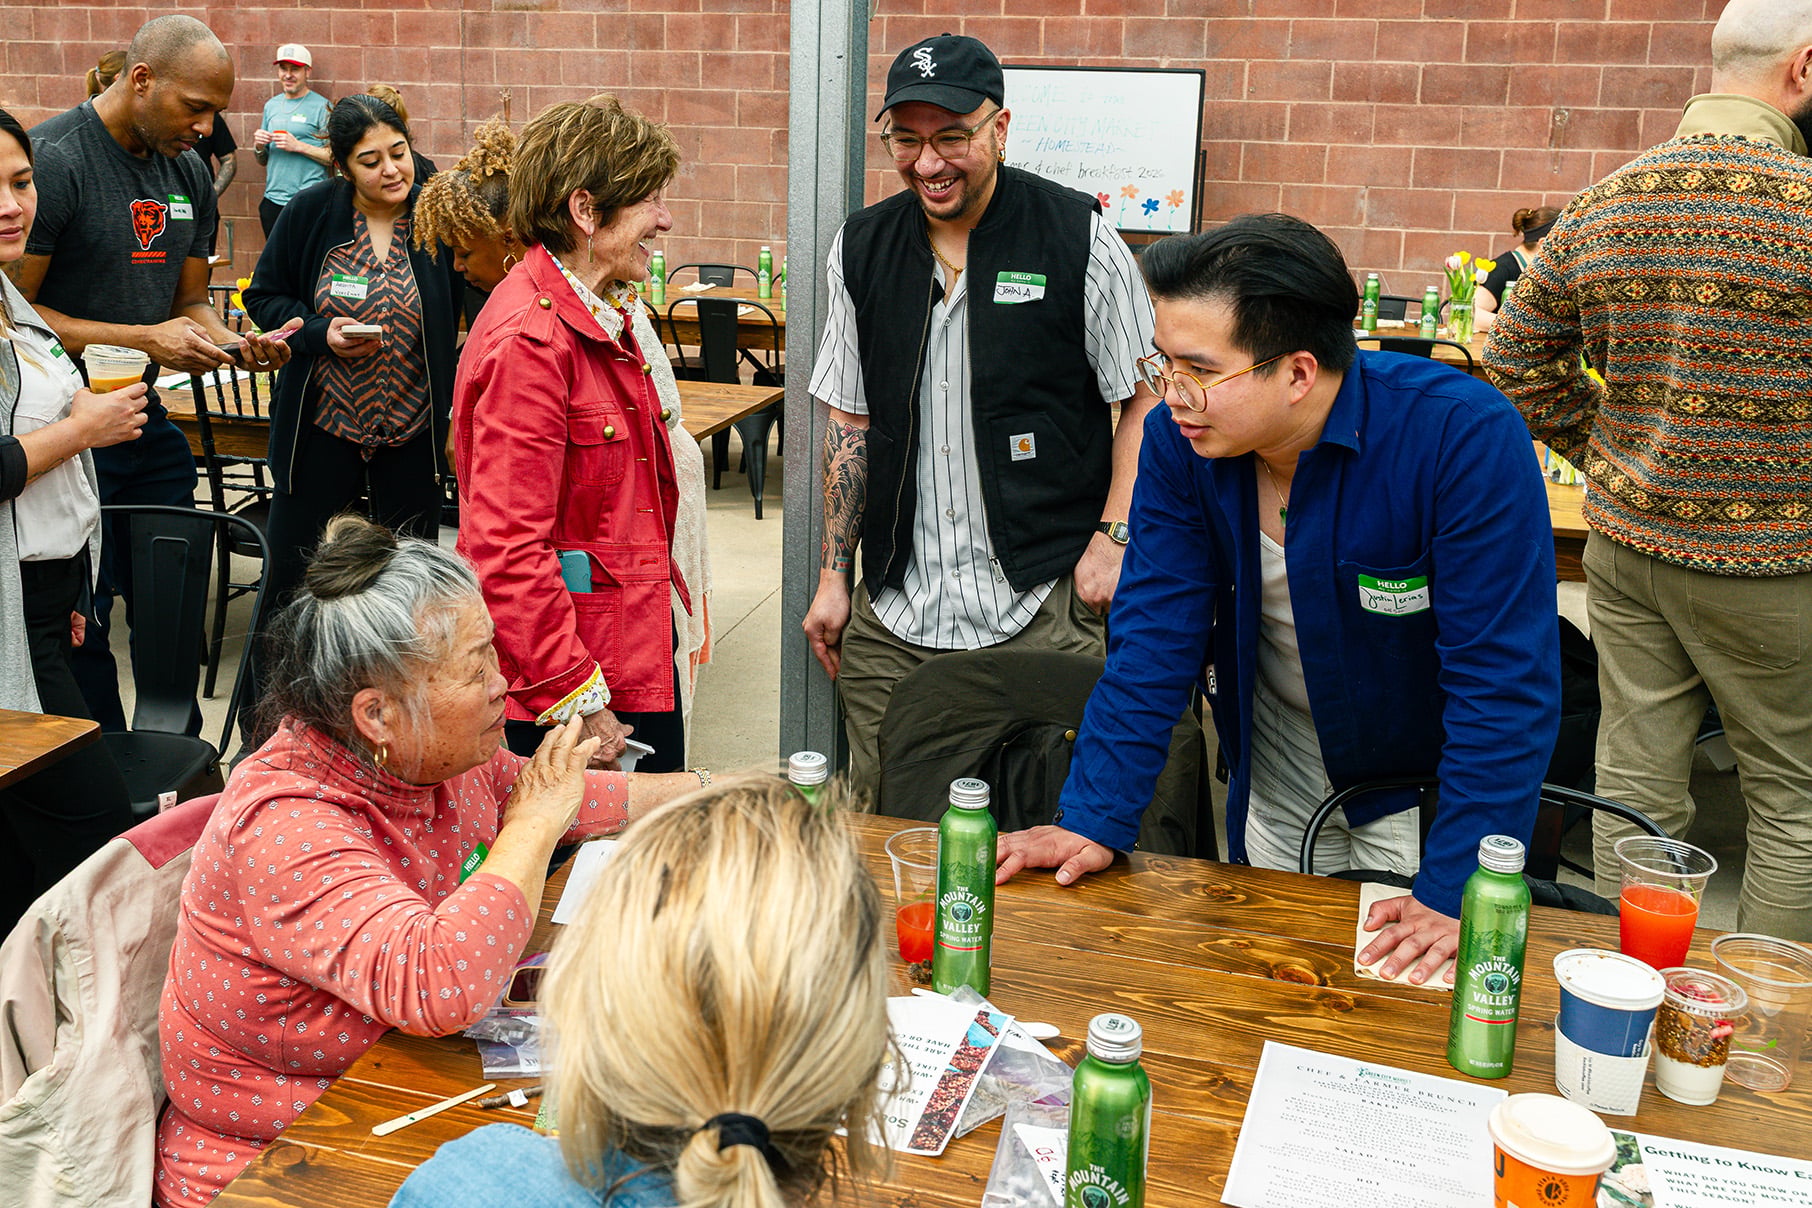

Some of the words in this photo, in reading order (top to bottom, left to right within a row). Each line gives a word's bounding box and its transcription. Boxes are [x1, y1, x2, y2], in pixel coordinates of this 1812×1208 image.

[1045, 160, 1072, 176] chef
[1077, 162, 1133, 180] breakfast
[1011, 273, 1032, 281] HELLO
[1377, 580, 1407, 589] HELLO
[464, 853, 480, 872] HELLO
[939, 891, 987, 914] MOUNTAIN
[942, 919, 981, 934] VALLEY
[940, 931, 960, 943] SPRING
[961, 935, 983, 944] WATER
[1468, 961, 1521, 985] MOUNTAIN
[1473, 991, 1515, 1006] VALLEY
[1468, 1003, 1493, 1016] SPRING
[1495, 1007, 1515, 1016] WATER
[926, 1039, 950, 1048] HAVE
[1296, 1065, 1331, 1076] CHEF
[1355, 1077, 1409, 1093] FARMER
[1418, 1090, 1476, 1107] BRUNCH
[1089, 1163, 1105, 1174] THE
[1644, 1145, 1711, 1165] Getting
[1715, 1157, 1733, 1167] to
[1737, 1160, 1789, 1177] Know
[1068, 1169, 1130, 1205] MOUNTAIN
[1663, 1168, 1697, 1179] WHAT
[1701, 1175, 1718, 1183] DO
[1722, 1178, 1747, 1187] YOU
[1751, 1184, 1788, 1194] GROW
[1665, 1177, 1699, 1188] WHAT
[1704, 1184, 1728, 1192] ARE
[1731, 1188, 1757, 1197] YOU
[1760, 1193, 1794, 1203] MOST
[1668, 1186, 1697, 1195] THIS
[1701, 1191, 1756, 1205] SEASON?
